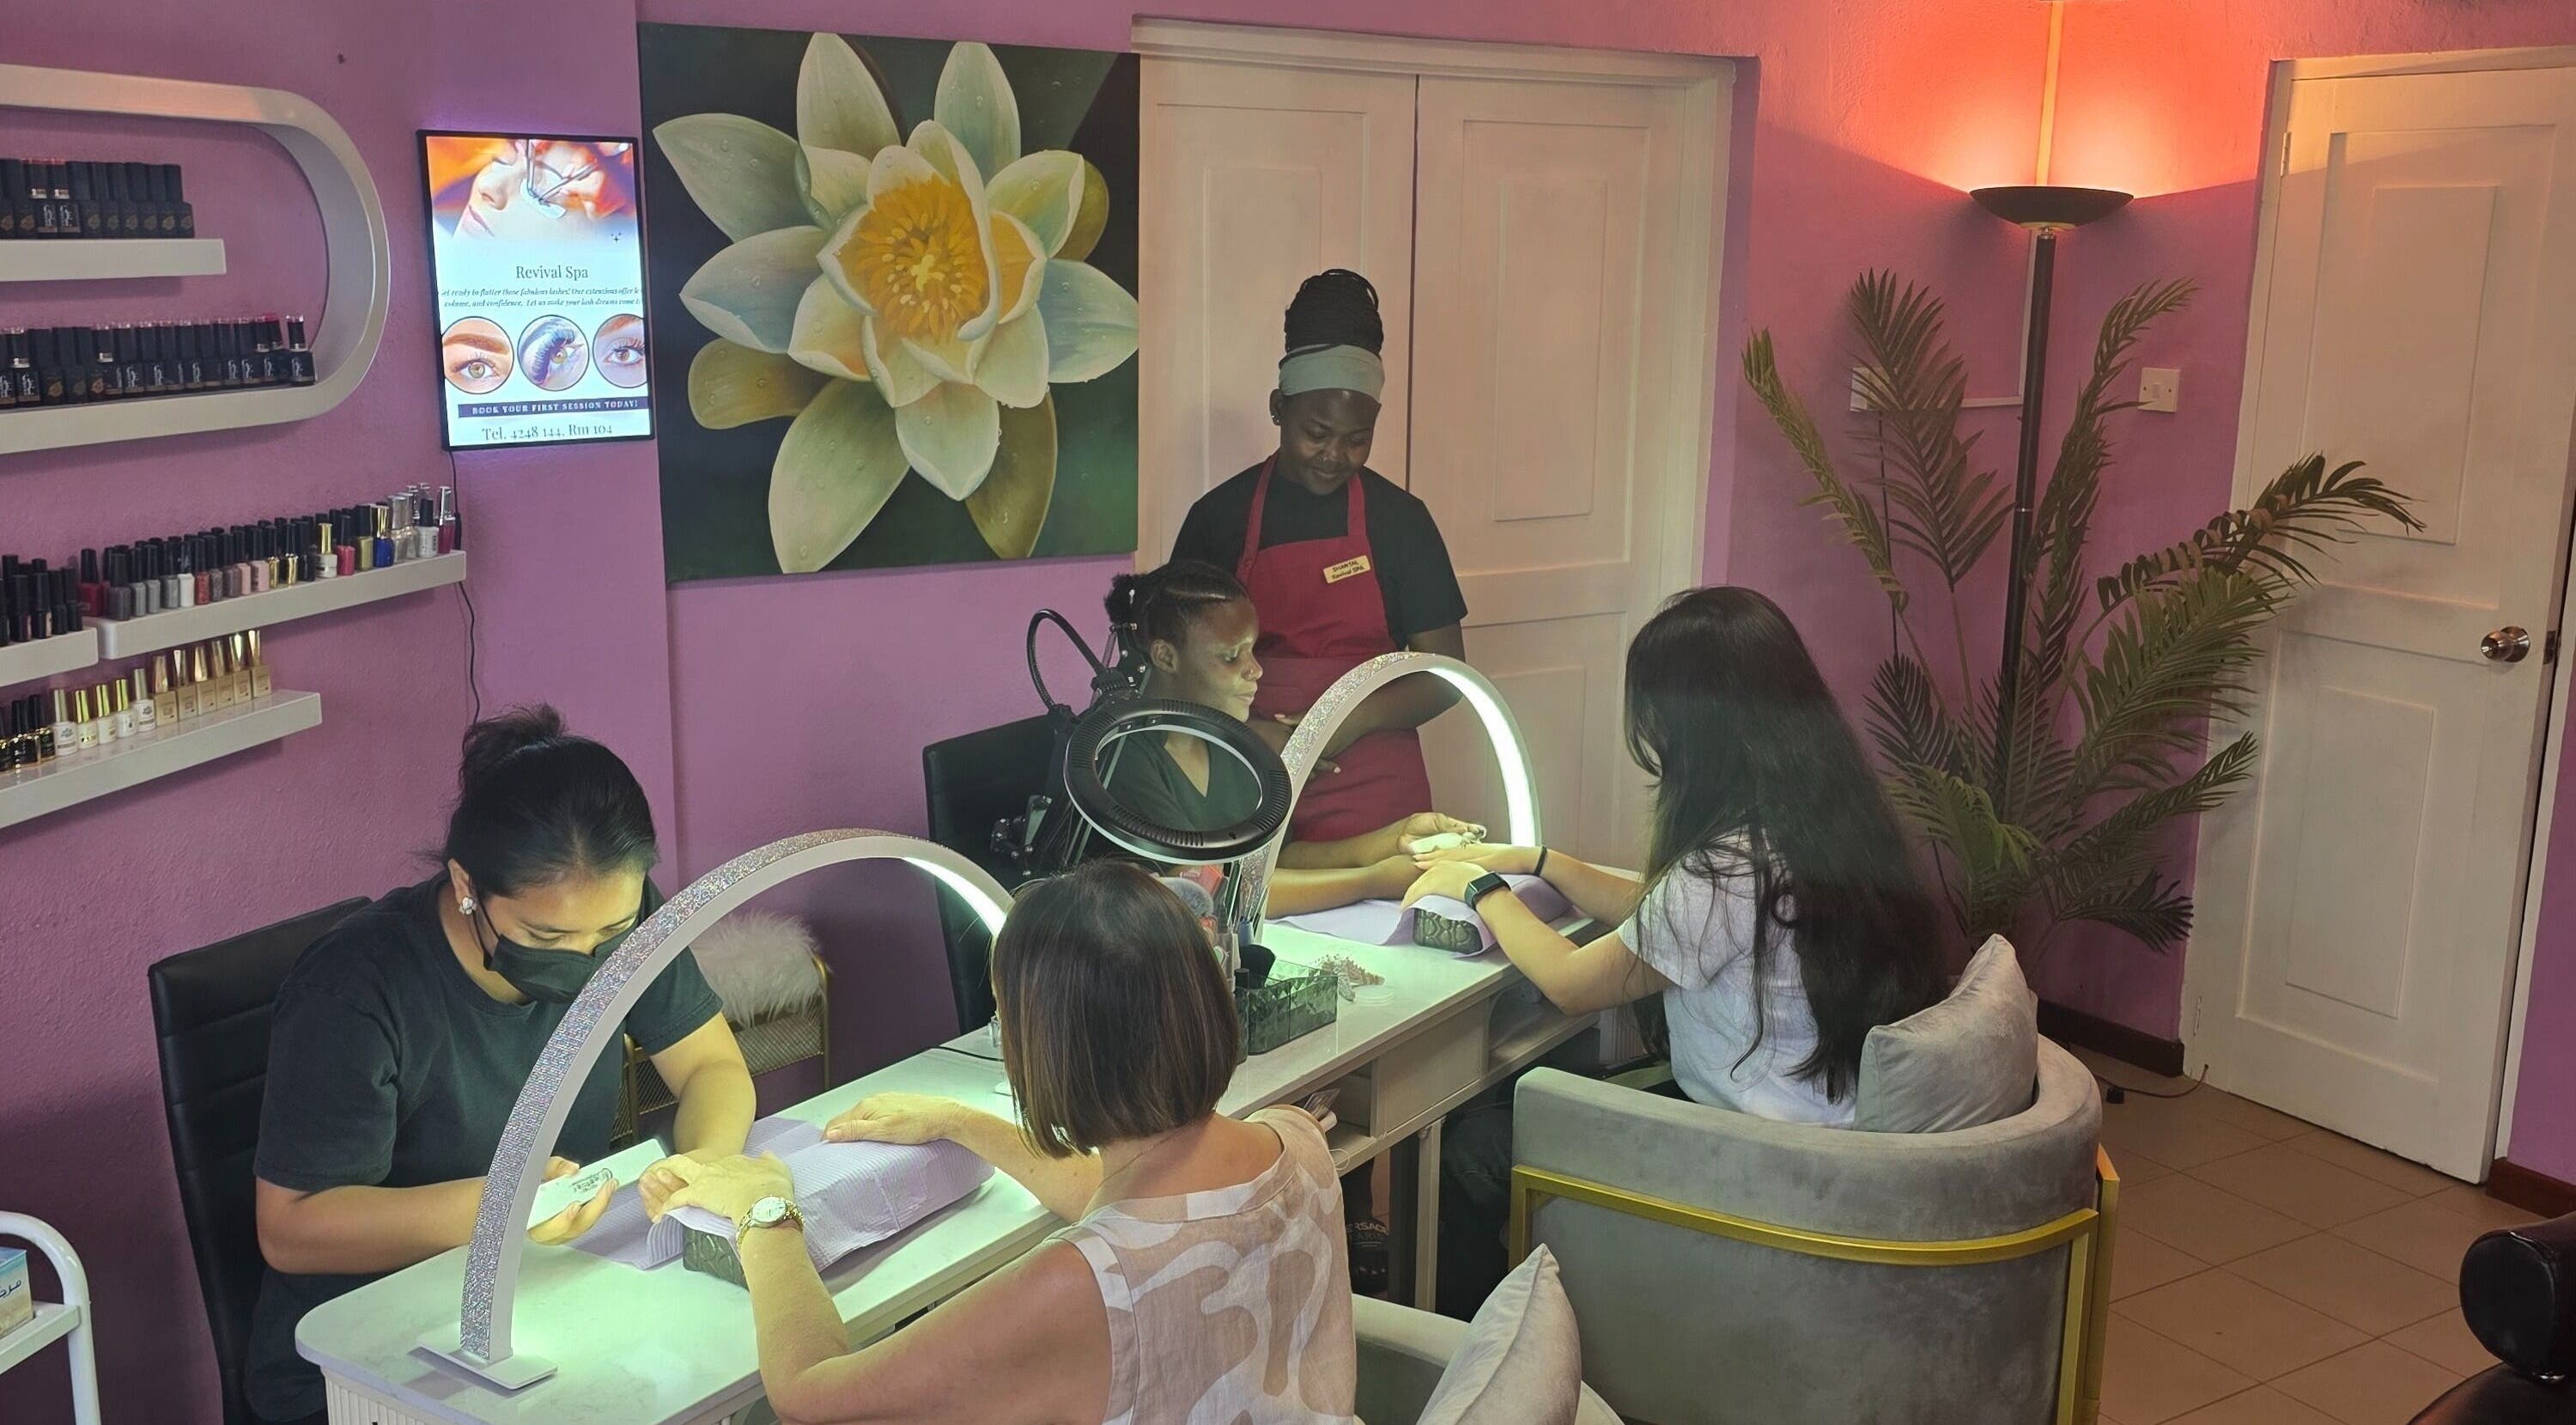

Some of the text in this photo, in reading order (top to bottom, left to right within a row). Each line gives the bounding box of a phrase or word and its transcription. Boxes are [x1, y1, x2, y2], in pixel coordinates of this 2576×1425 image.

[515, 265, 589, 281] Revival Spa
[452, 289, 471, 297] ready
[520, 288, 548, 296] fabulous
[618, 287, 634, 295] offer
[472, 399, 638, 415] BOOK YOUR FIRST SESSION TODAY!
[481, 426, 507, 441] Tel.
[510, 425, 538, 439] 4248
[568, 423, 589, 435] Rm
[593, 424, 612, 435] 104
